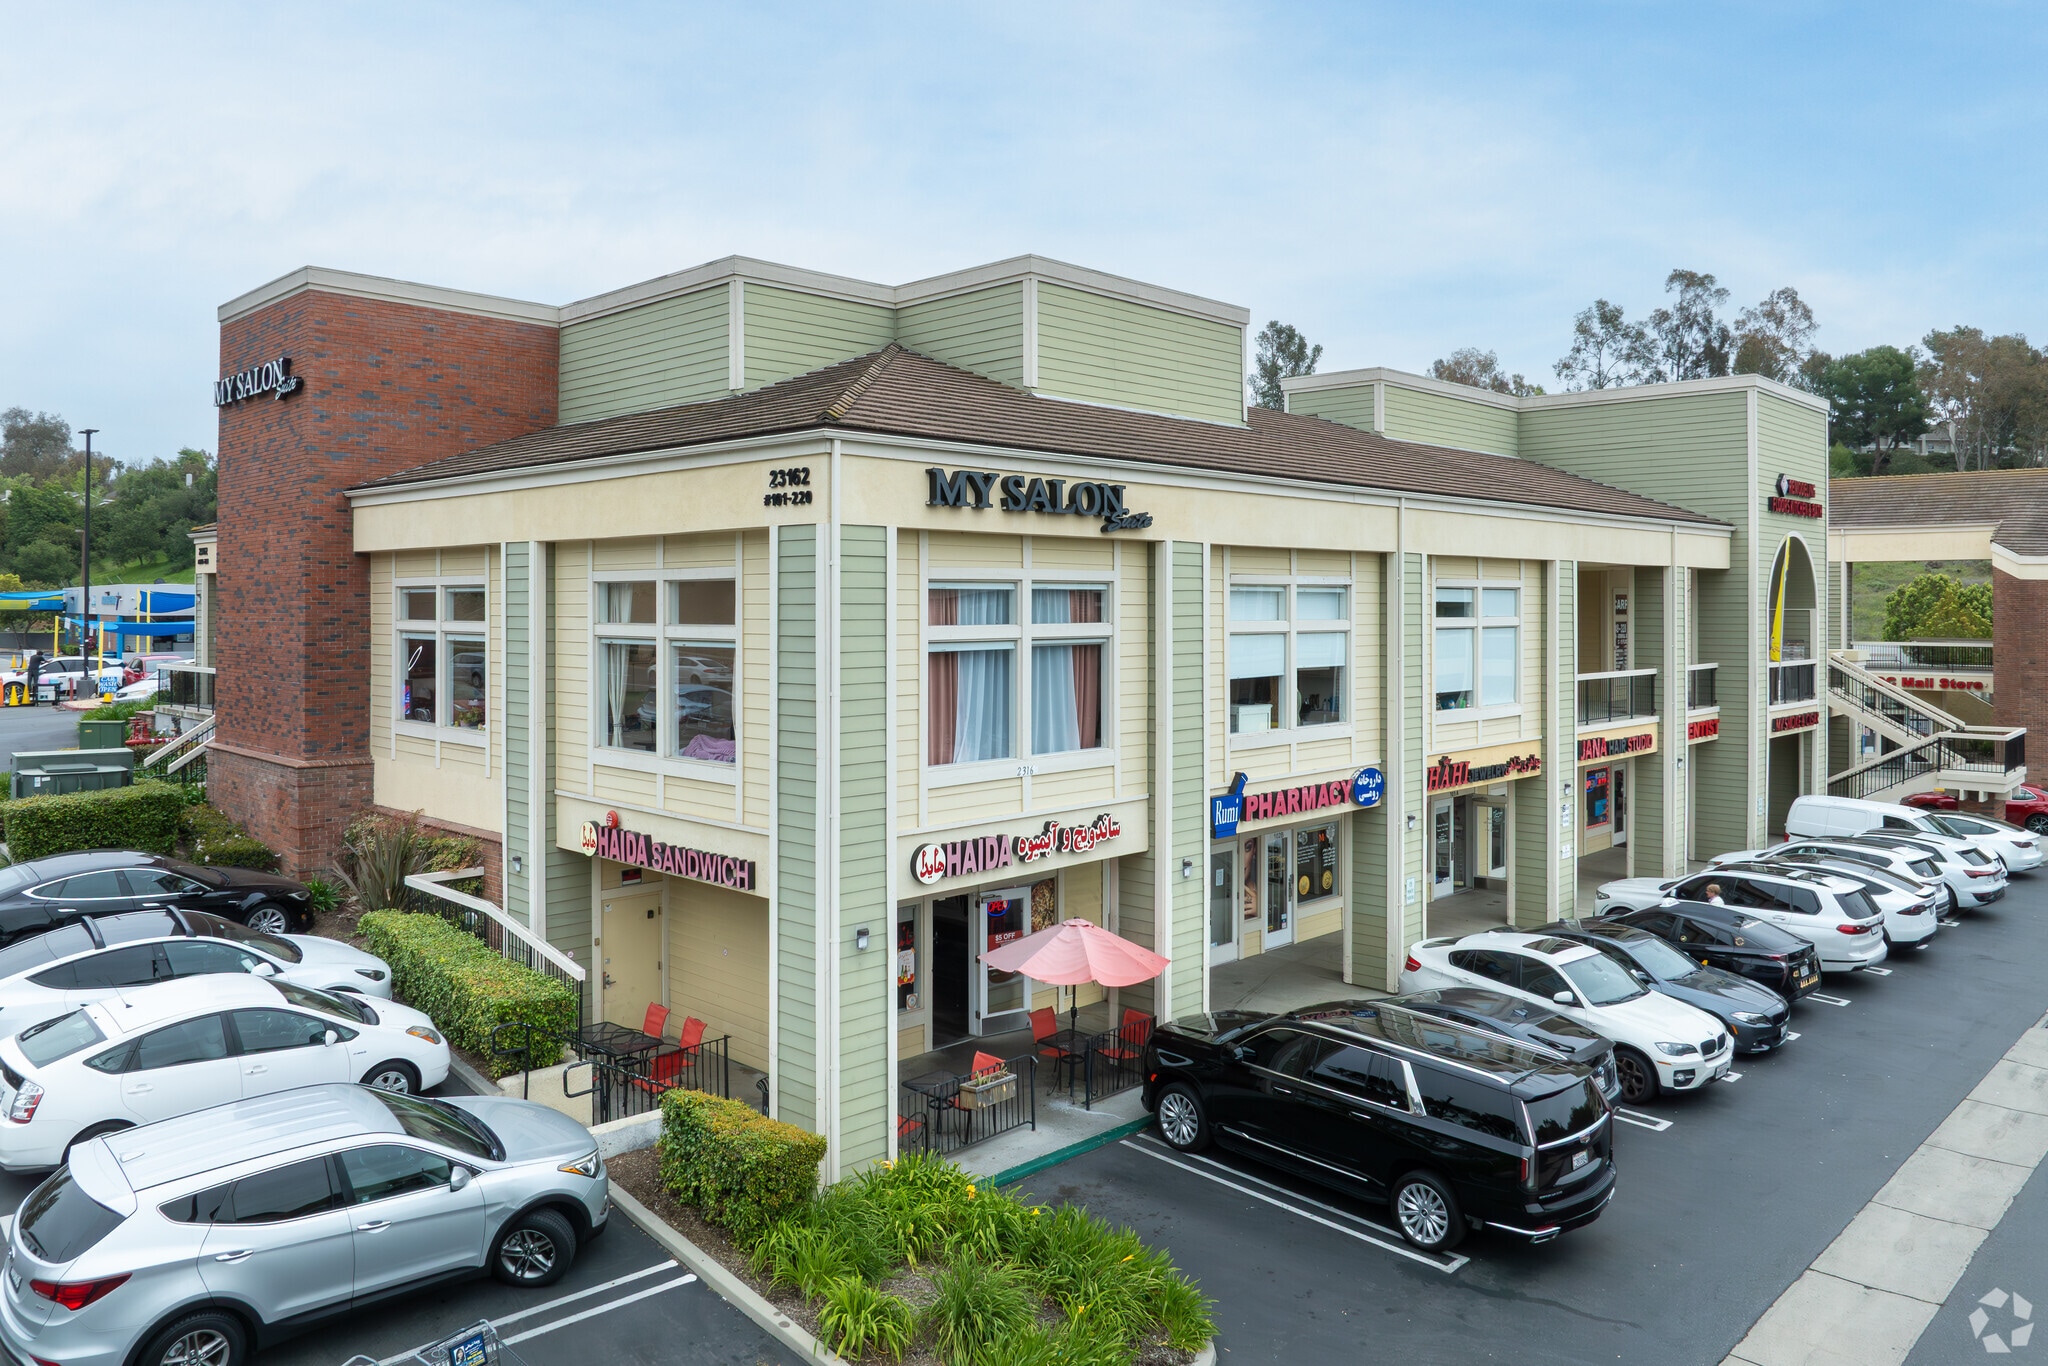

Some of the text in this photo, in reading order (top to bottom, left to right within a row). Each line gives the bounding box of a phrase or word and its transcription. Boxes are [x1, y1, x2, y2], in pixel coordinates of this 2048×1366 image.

[213, 358, 284, 407] MY SALON
[275, 376, 297, 400] Suite
[769, 467, 810, 487] 23162
[930, 467, 1126, 516] MY SALON
[1104, 509, 1153, 532] Suite
[1902, 677, 1934, 689] Mail
[1939, 678, 1984, 690] Store
[1688, 719, 1720, 740] ENTIST
[1580, 734, 1652, 760] JANA HAIR STUDIO
[1017, 766, 1034, 776] 2316
[1357, 772, 1382, 788] داروخانه
[1427, 761, 1506, 791] HAHI JEWELRY
[1215, 798, 1239, 826] Rumi
[1246, 779, 1353, 821] PHARMACY
[1018, 814, 1121, 863] ساندویچ و آبمیوه
[597, 826, 749, 890] HAIDA SANDWICH
[946, 834, 1013, 878] HAIDA
[995, 932, 1015, 942] $5 OFF
